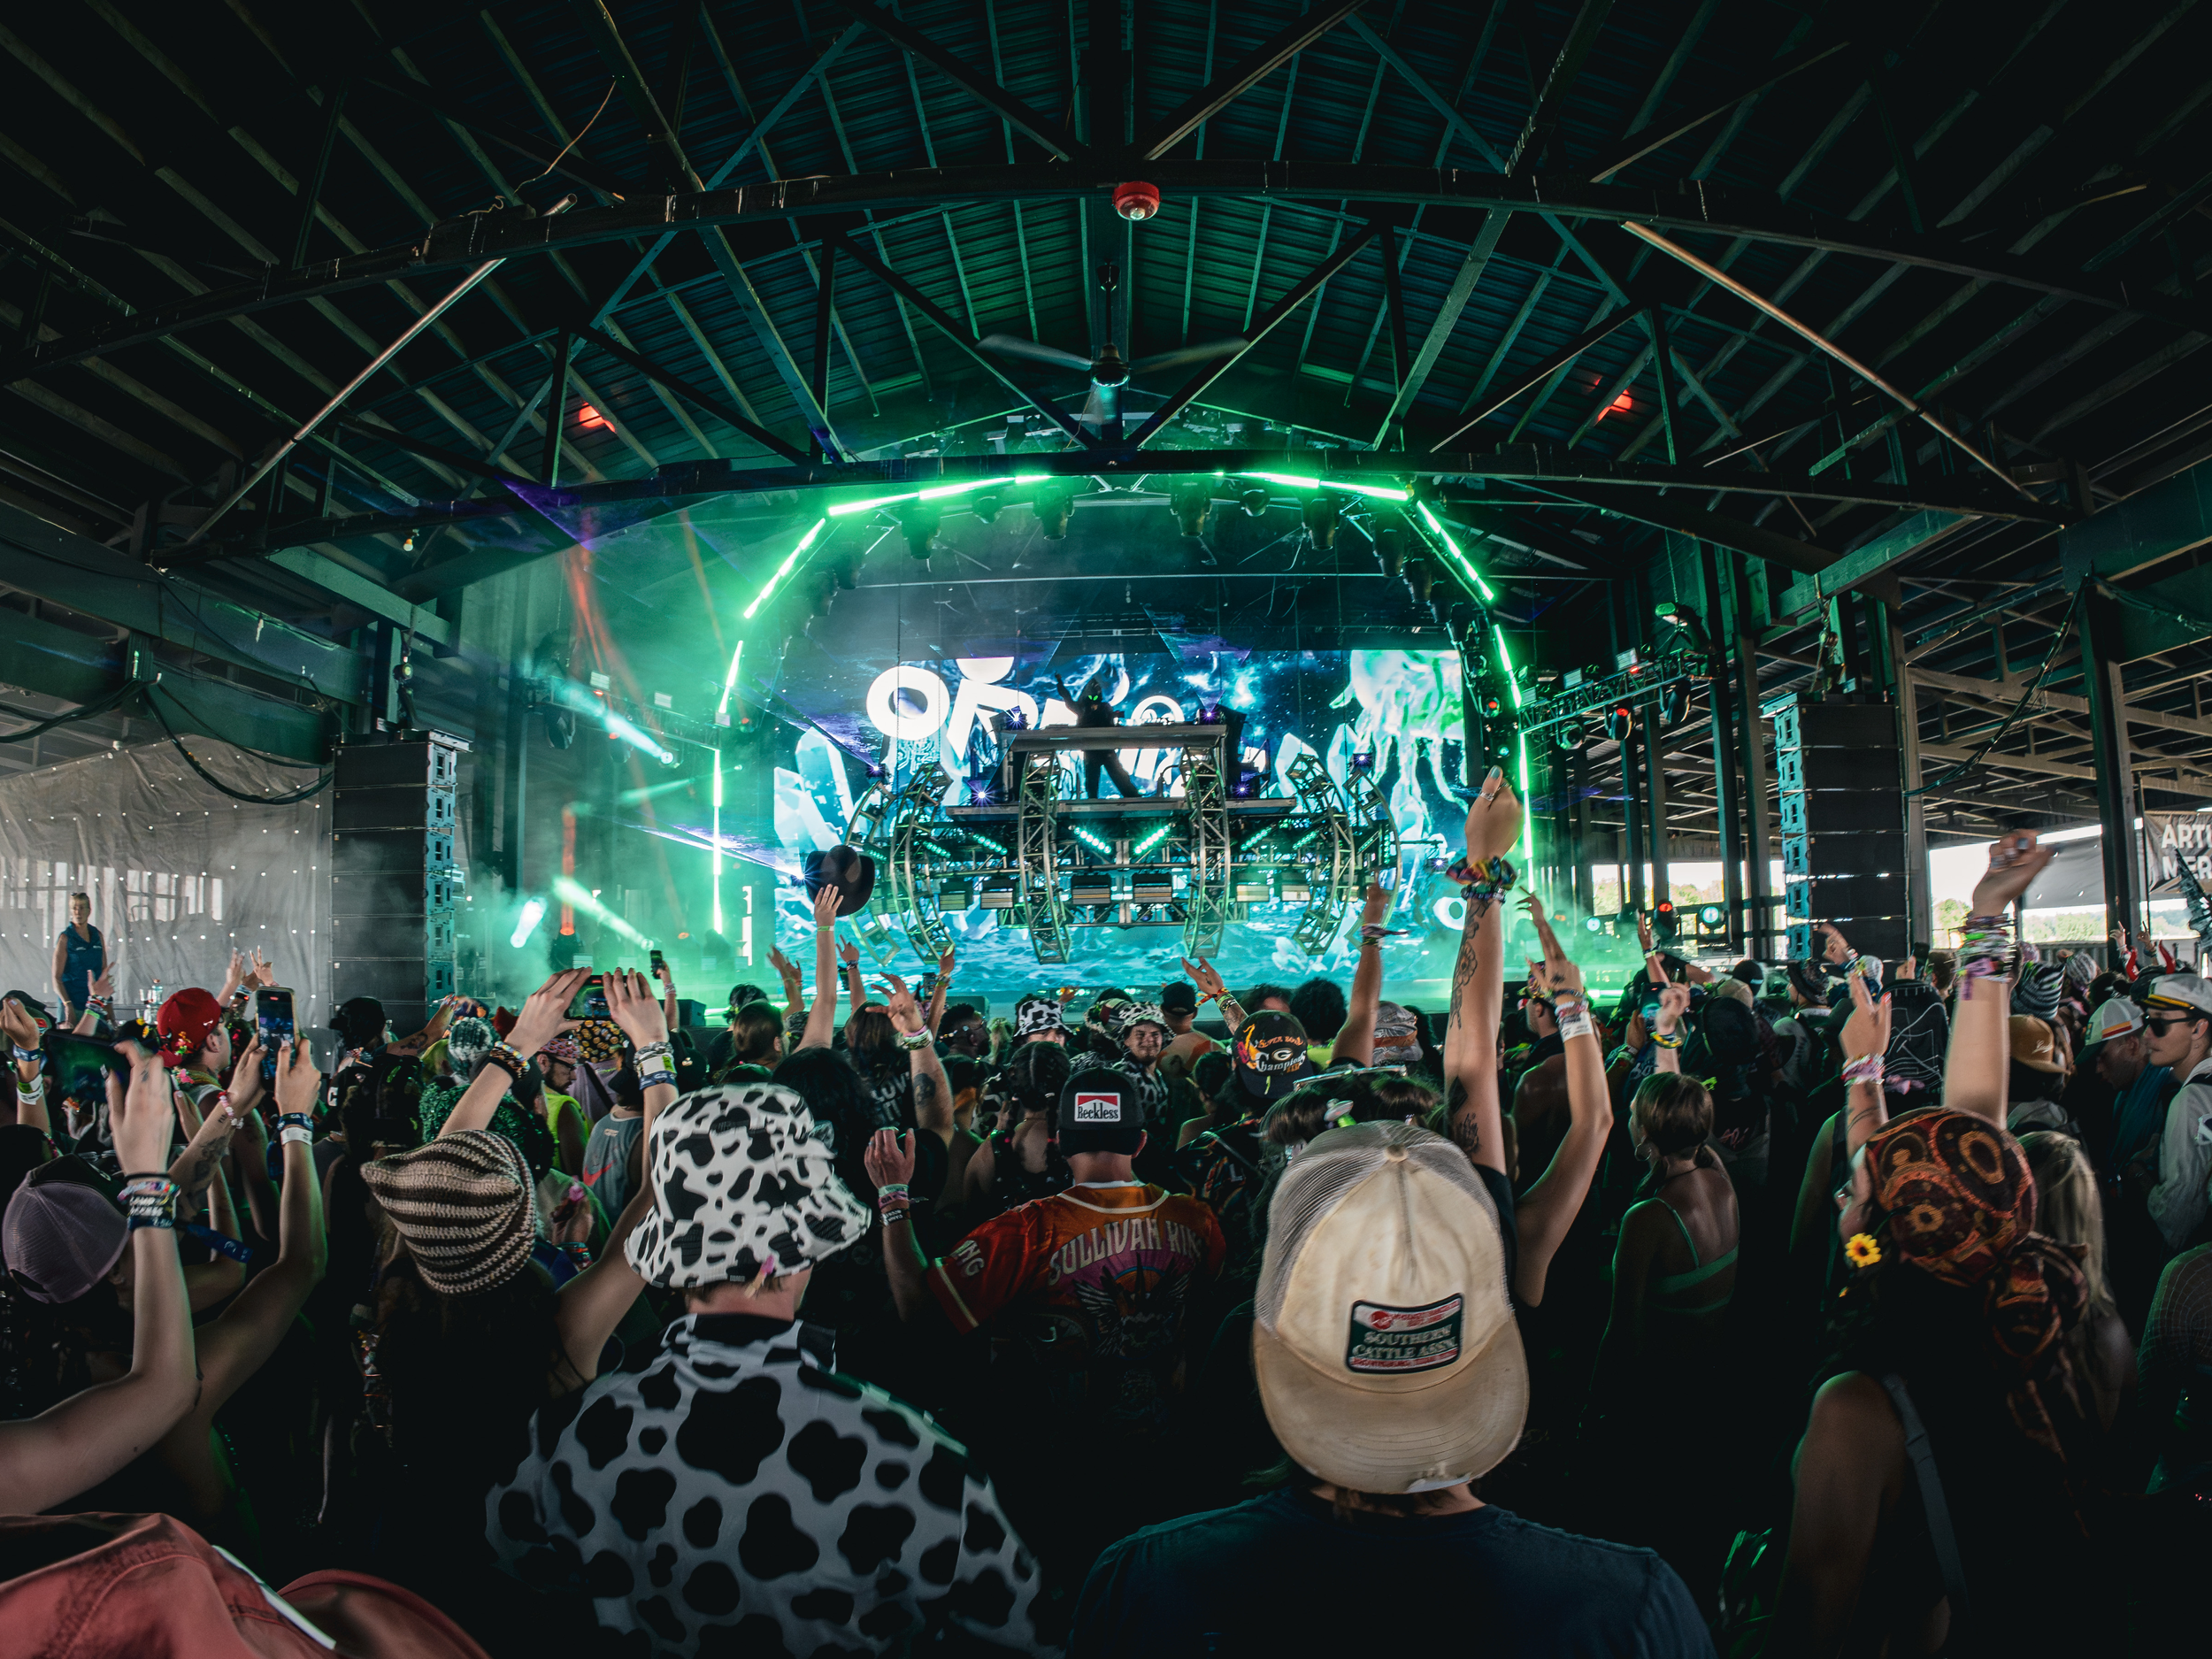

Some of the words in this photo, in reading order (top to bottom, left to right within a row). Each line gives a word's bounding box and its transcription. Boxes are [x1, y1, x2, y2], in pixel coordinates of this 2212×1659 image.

[2161, 824, 2212, 849] ARTI
[2162, 855, 2212, 880] MER
[870, 1071, 910, 1102] LOV
[1077, 1102, 1119, 1119] Reckless
[1048, 1217, 1163, 1286] SULLIVAN
[1363, 1324, 1453, 1346] SOUTHERN
[1352, 1344, 1416, 1360] CATTLE
